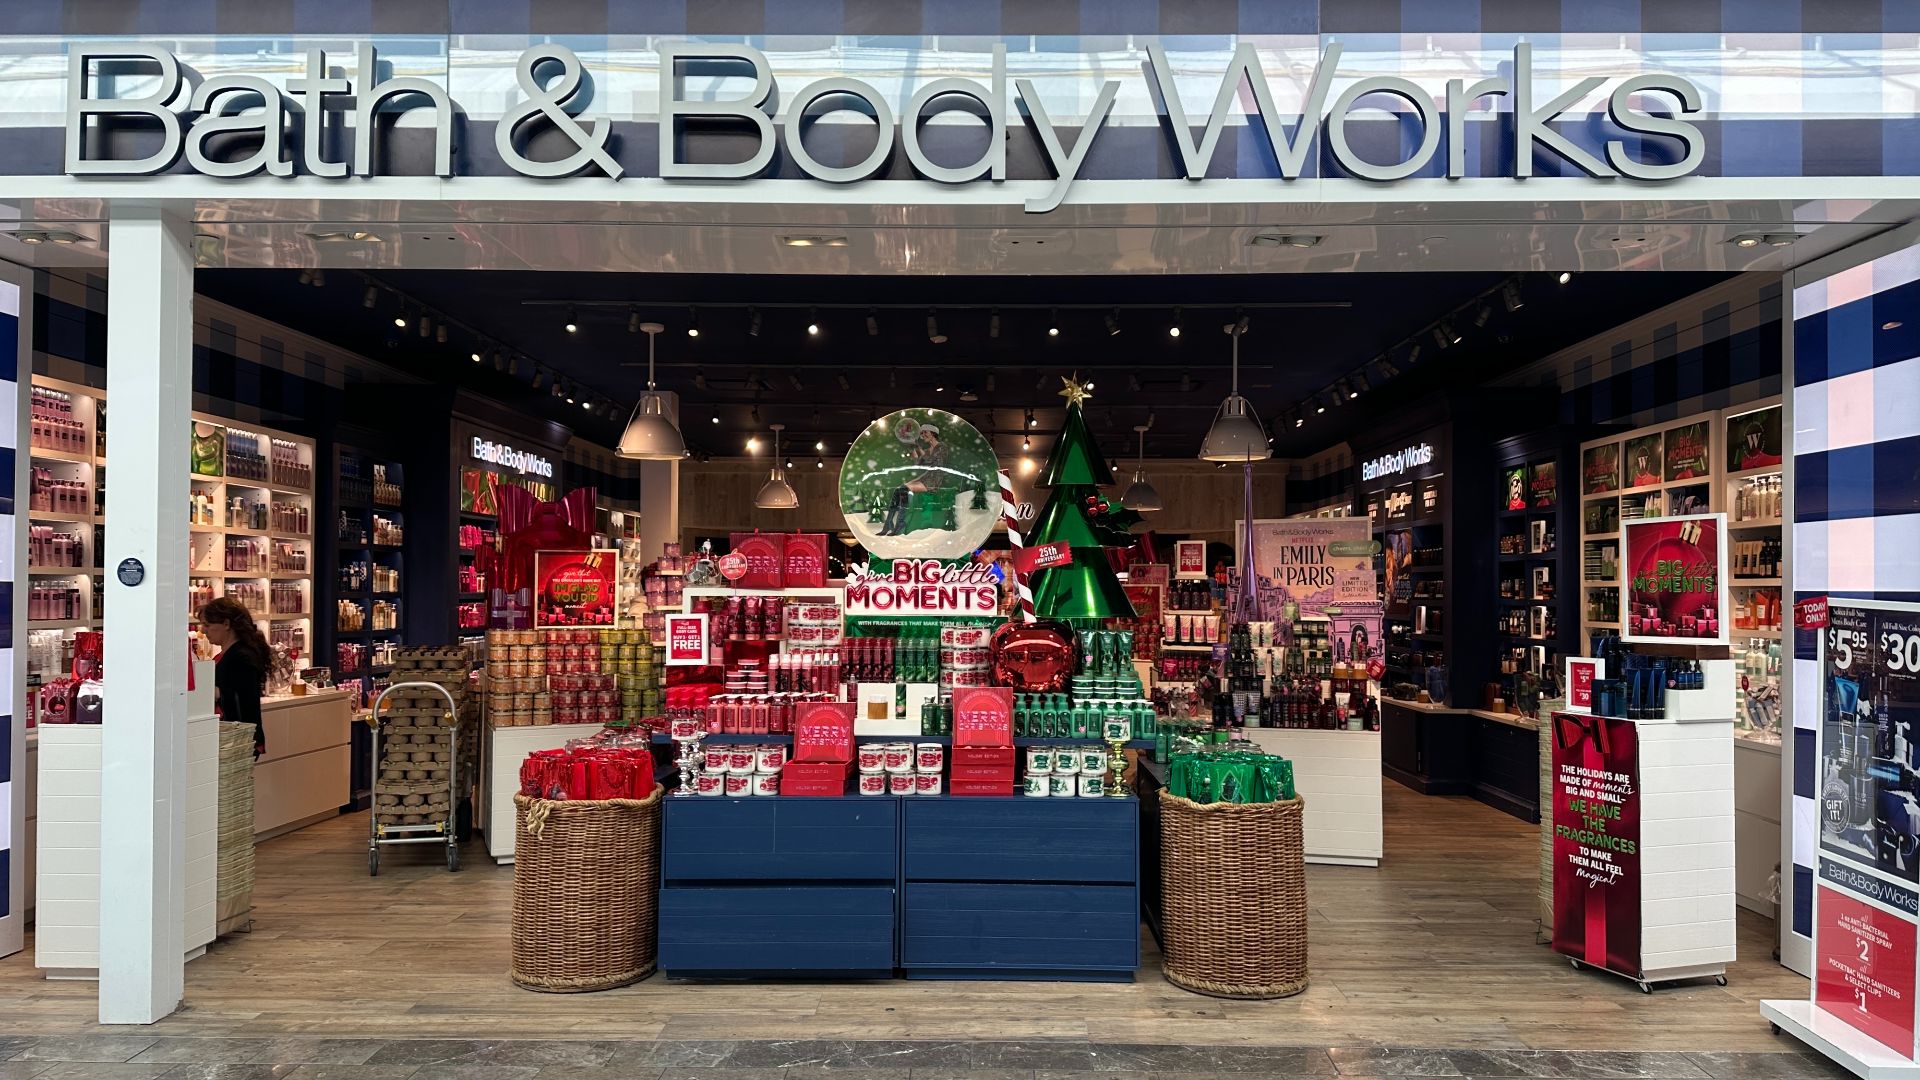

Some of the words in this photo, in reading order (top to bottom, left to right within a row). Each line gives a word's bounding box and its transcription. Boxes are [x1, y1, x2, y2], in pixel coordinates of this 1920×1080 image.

[65, 44, 455, 179] Bath
[495, 44, 625, 182] &
[659, 43, 1121, 214] Body
[1145, 42, 1706, 182] Works
[473, 436, 497, 463] Bath
[505, 446, 528, 475] Body
[527, 453, 552, 478] Works
[1363, 459, 1379, 481] Bath
[1385, 450, 1405, 475] Body
[1405, 443, 1431, 468] Works
[726, 557, 740, 565] 25th
[1039, 546, 1058, 557] 25th
[1280, 545, 1326, 565] EMILY
[1181, 558, 1202, 566] FREE
[1657, 560, 1684, 576] BIG
[855, 569, 894, 592] give
[894, 560, 940, 584] BIG
[942, 563, 999, 584] little
[1273, 567, 1283, 579] IN
[1286, 566, 1335, 589] PARIS
[1632, 576, 1715, 593] MOMENTS
[556, 593, 579, 602] YOU
[581, 593, 599, 602] DID
[846, 585, 996, 611] MOMENTS
[1803, 602, 1827, 614] TODAY
[1805, 612, 1827, 624] ONLY!
[673, 640, 701, 650] FREE
[1881, 631, 1920, 673] $30
[960, 711, 1008, 722] MERRY
[801, 726, 850, 738] MERRY
[1561, 764, 1576, 775] THE
[1576, 767, 1613, 781] HOLIDAYS
[1614, 772, 1630, 784] ARE
[1560, 774, 1581, 787] MADE
[1581, 778, 1592, 788] OF
[1592, 780, 1636, 796] moments
[1565, 785, 1578, 796] BIG
[1579, 788, 1595, 799] AND
[1570, 799, 1587, 813] WE
[1589, 801, 1621, 820] HAVE
[1826, 799, 1843, 811] GIFT
[1582, 815, 1606, 833] THE
[1830, 810, 1841, 821] IT!
[1556, 824, 1636, 855] FRAGRANCES
[1579, 846, 1590, 856] TO
[1590, 848, 1612, 862] MAKE
[1568, 854, 1590, 867] THEM
[1590, 858, 1604, 871] ALL
[1605, 862, 1624, 876] FEEL
[1829, 863, 1851, 884] Bath
[1850, 872, 1859, 887] &
[1857, 876, 1884, 899] Body
[1883, 885, 1918, 910] Works
[1837, 920, 1851, 932] HAND
[1851, 925, 1876, 943] SANITIZER
[1875, 936, 1893, 950] SPRAY
[1855, 937, 1869, 962] $2
[1829, 957, 1857, 978] POCKETBAC
[1857, 971, 1871, 984] HAND
[1871, 979, 1901, 999] SANITIZERS
[1849, 976, 1867, 990] SELECT
[1867, 985, 1882, 998] CLIPS
[1854, 988, 1868, 1013] $1
